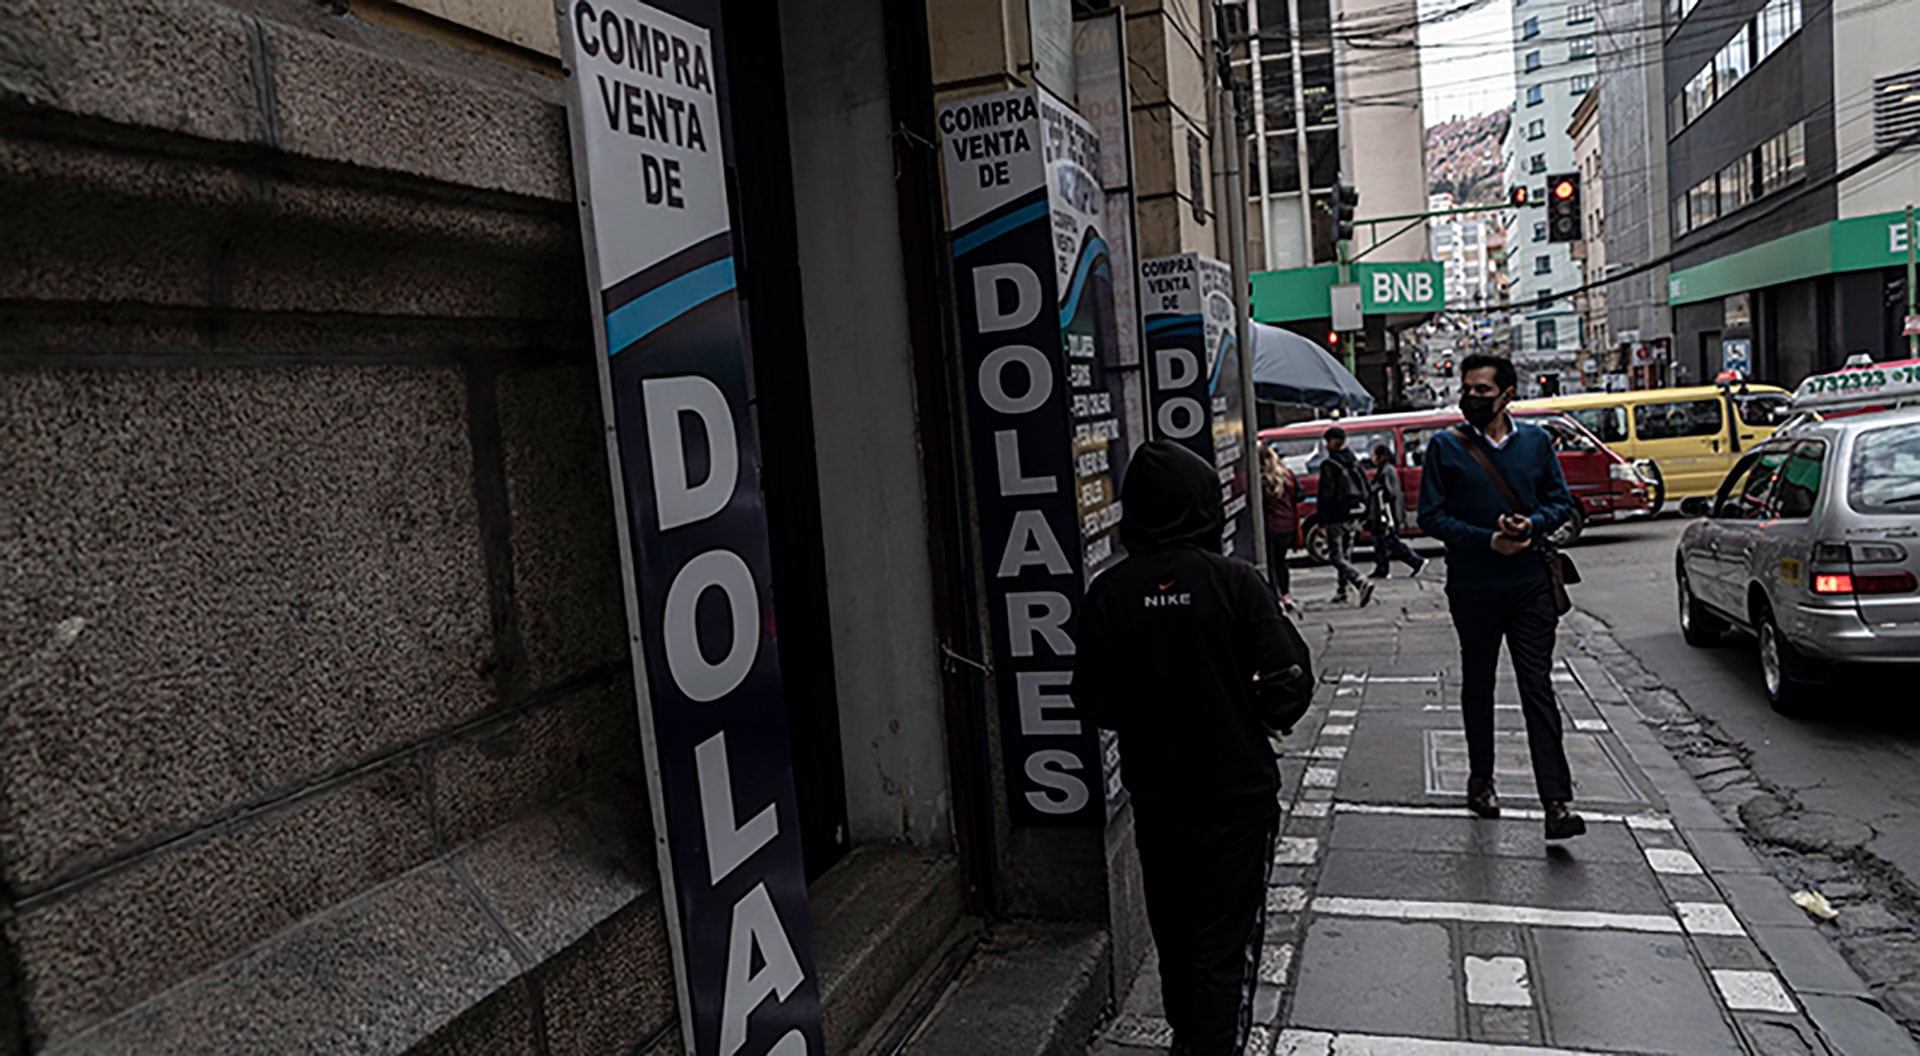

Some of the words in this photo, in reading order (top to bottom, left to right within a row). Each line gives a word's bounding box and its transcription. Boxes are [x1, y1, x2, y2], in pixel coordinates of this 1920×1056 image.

[576, 1, 712, 94] COMPRA
[598, 75, 707, 152] VENTA
[939, 96, 1038, 134] COMPRA
[952, 128, 1030, 162] VENTA
[641, 153, 684, 208] DE
[979, 161, 1010, 188] DE
[1142, 258, 1195, 278] COMPRA
[1149, 276, 1190, 294] VENTA
[1162, 294, 1179, 310] DE
[1373, 272, 1433, 302] BNB
[972, 262, 1089, 814] DOLARES
[1144, 592, 1191, 607] NIKE
[642, 375, 808, 1056] DOLA
